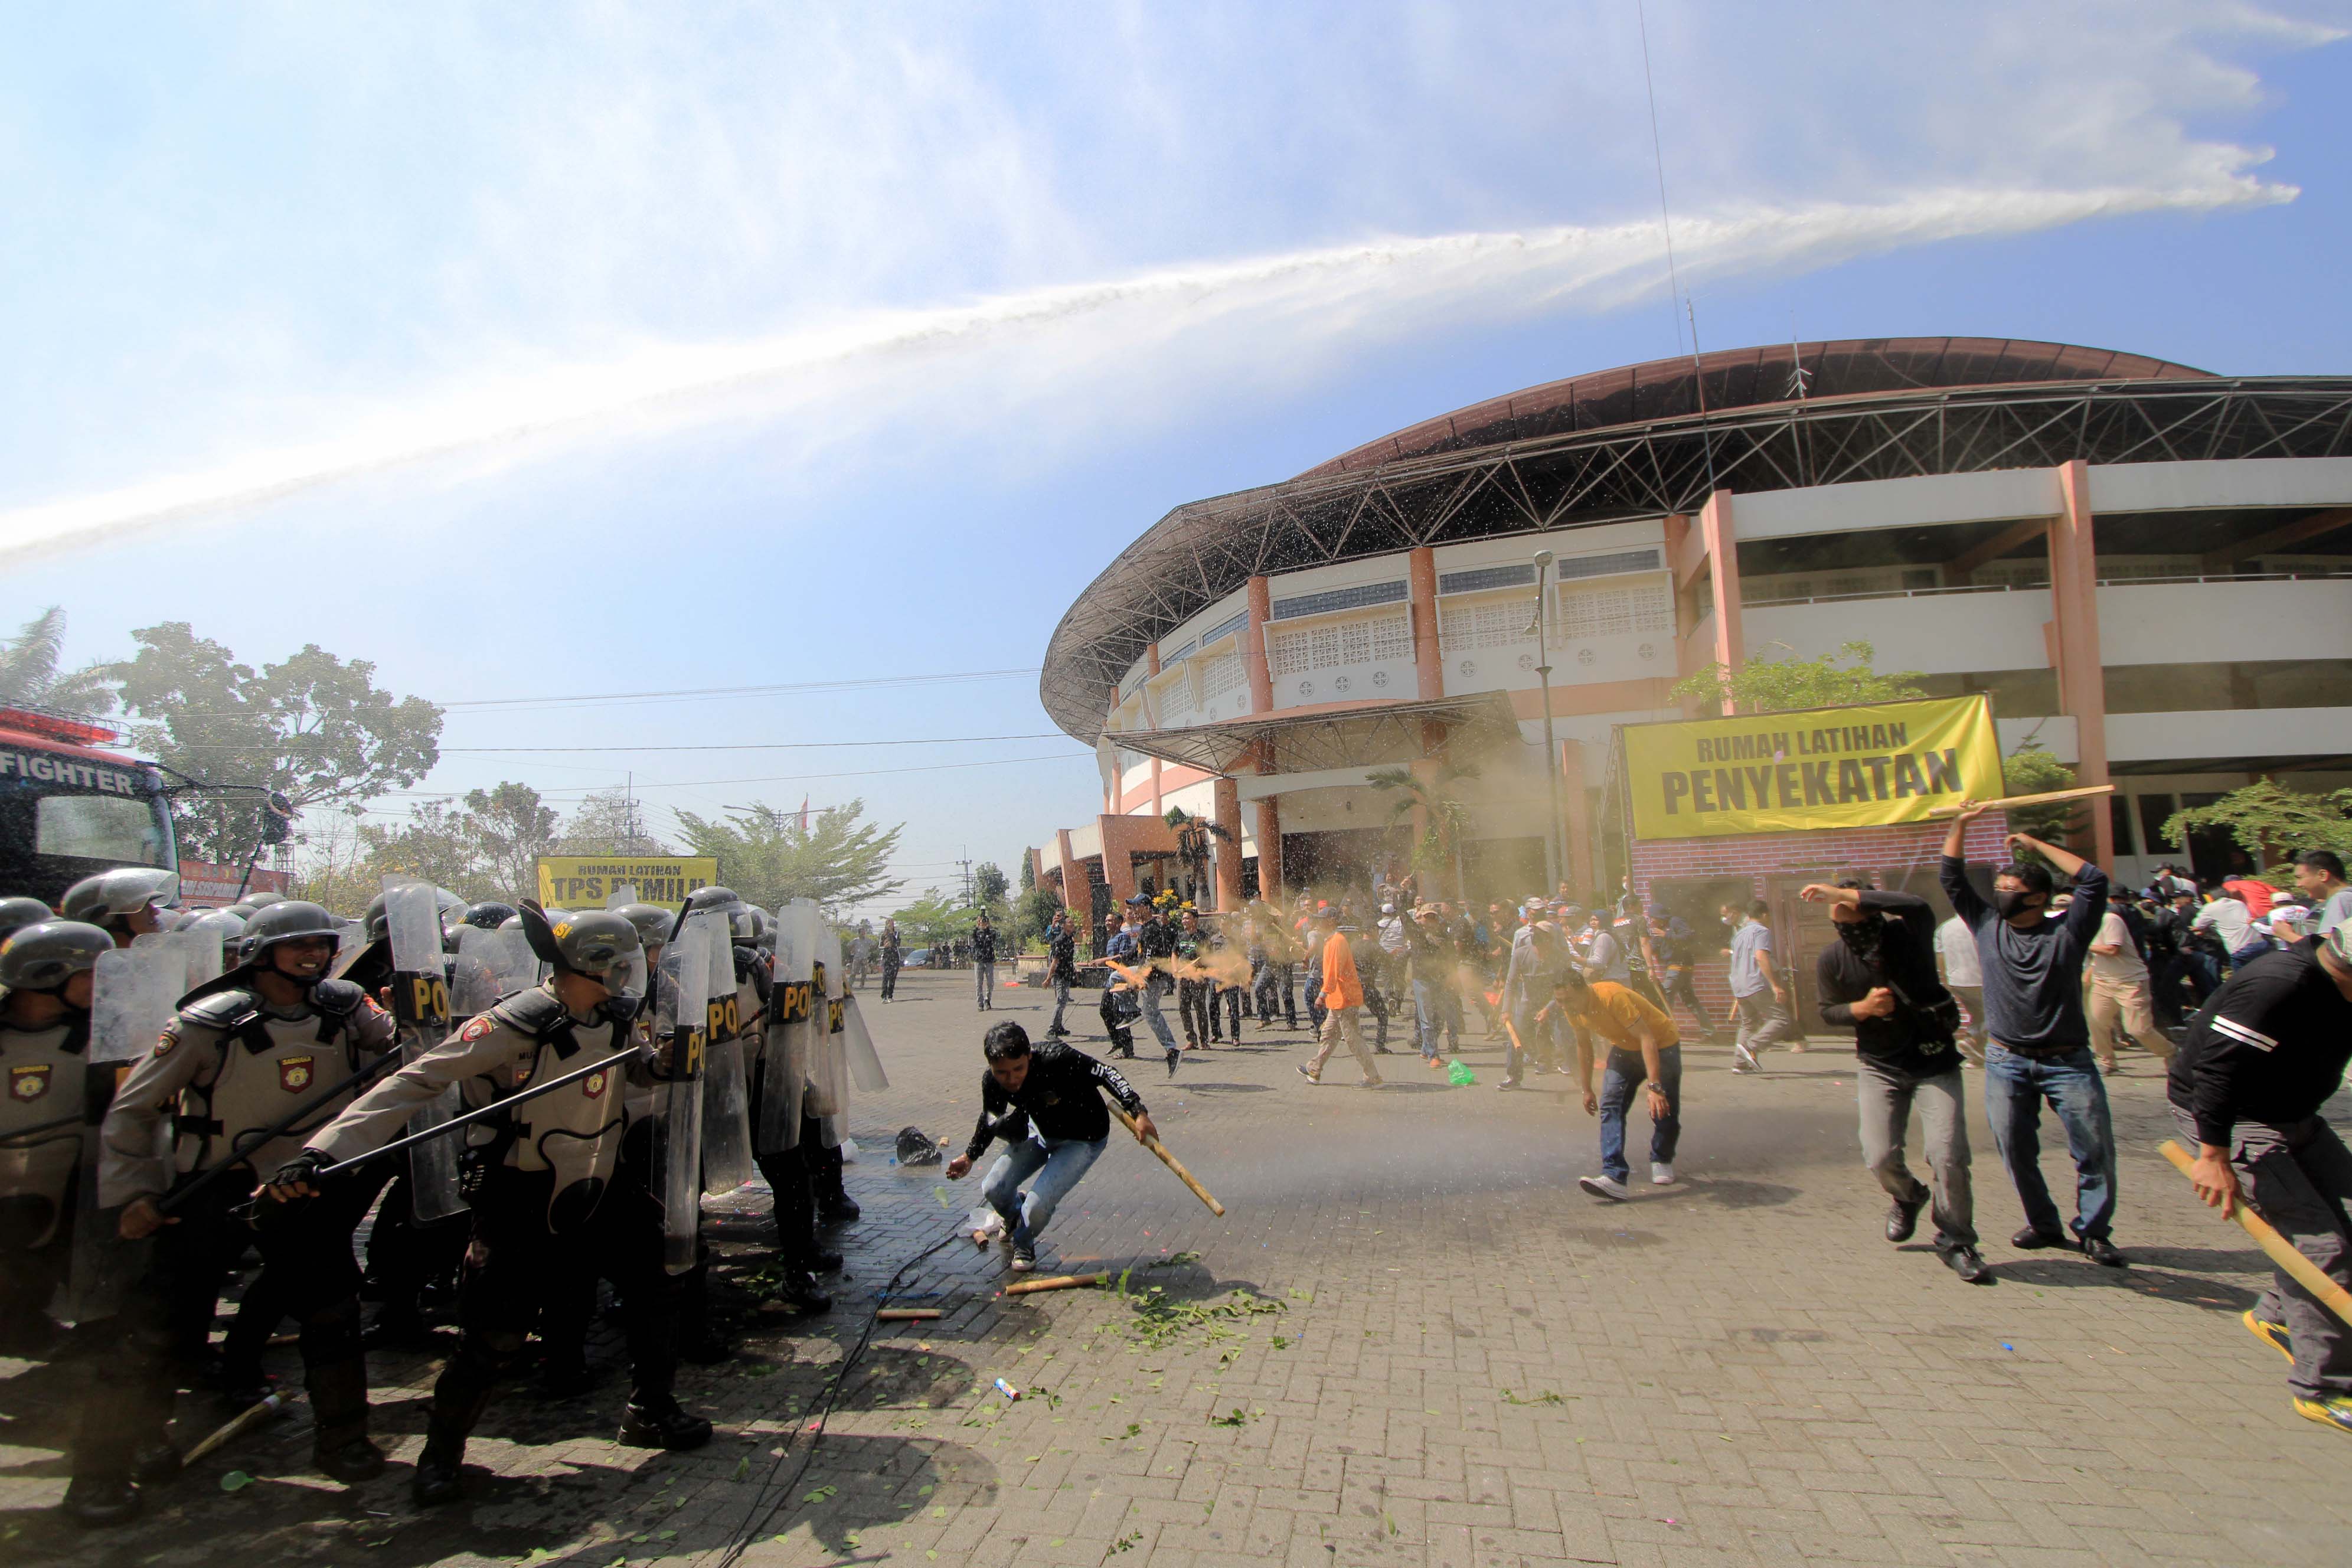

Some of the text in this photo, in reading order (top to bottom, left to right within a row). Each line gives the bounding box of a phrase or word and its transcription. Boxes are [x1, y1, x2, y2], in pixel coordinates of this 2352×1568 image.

[1697, 722, 1908, 762] RUMAH LATIHAN
[0, 751, 135, 795] FIGHTER
[1661, 748, 1963, 815] PENYEKATAN
[551, 877, 603, 900] TPS
[578, 865, 681, 876] RUMAH LATIHAN
[708, 998, 740, 1040] PO
[783, 985, 812, 1020] PO
